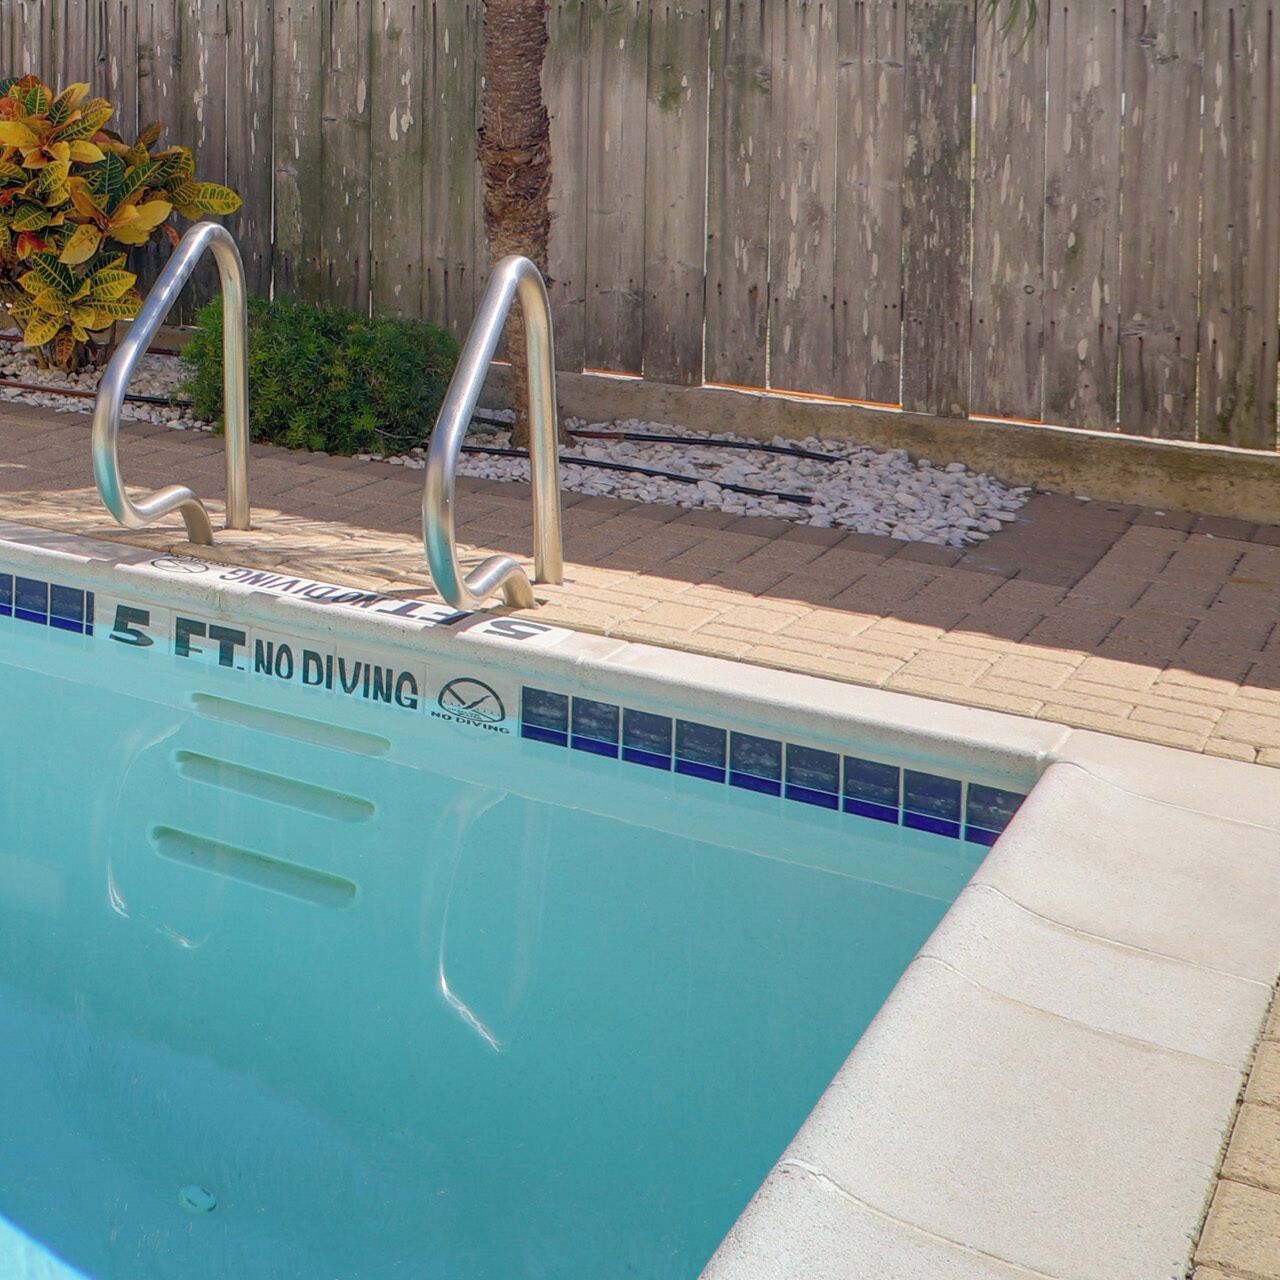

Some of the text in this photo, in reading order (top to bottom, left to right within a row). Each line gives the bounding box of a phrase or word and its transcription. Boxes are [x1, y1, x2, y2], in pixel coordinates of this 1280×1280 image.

[219, 568, 552, 641] 5 FT NO DIVING
[109, 604, 154, 647] 5
[255, 639, 294, 680] NO
[302, 649, 418, 710] DIVING
[430, 711, 452, 721] NO
[456, 719, 511, 735] DIVING
